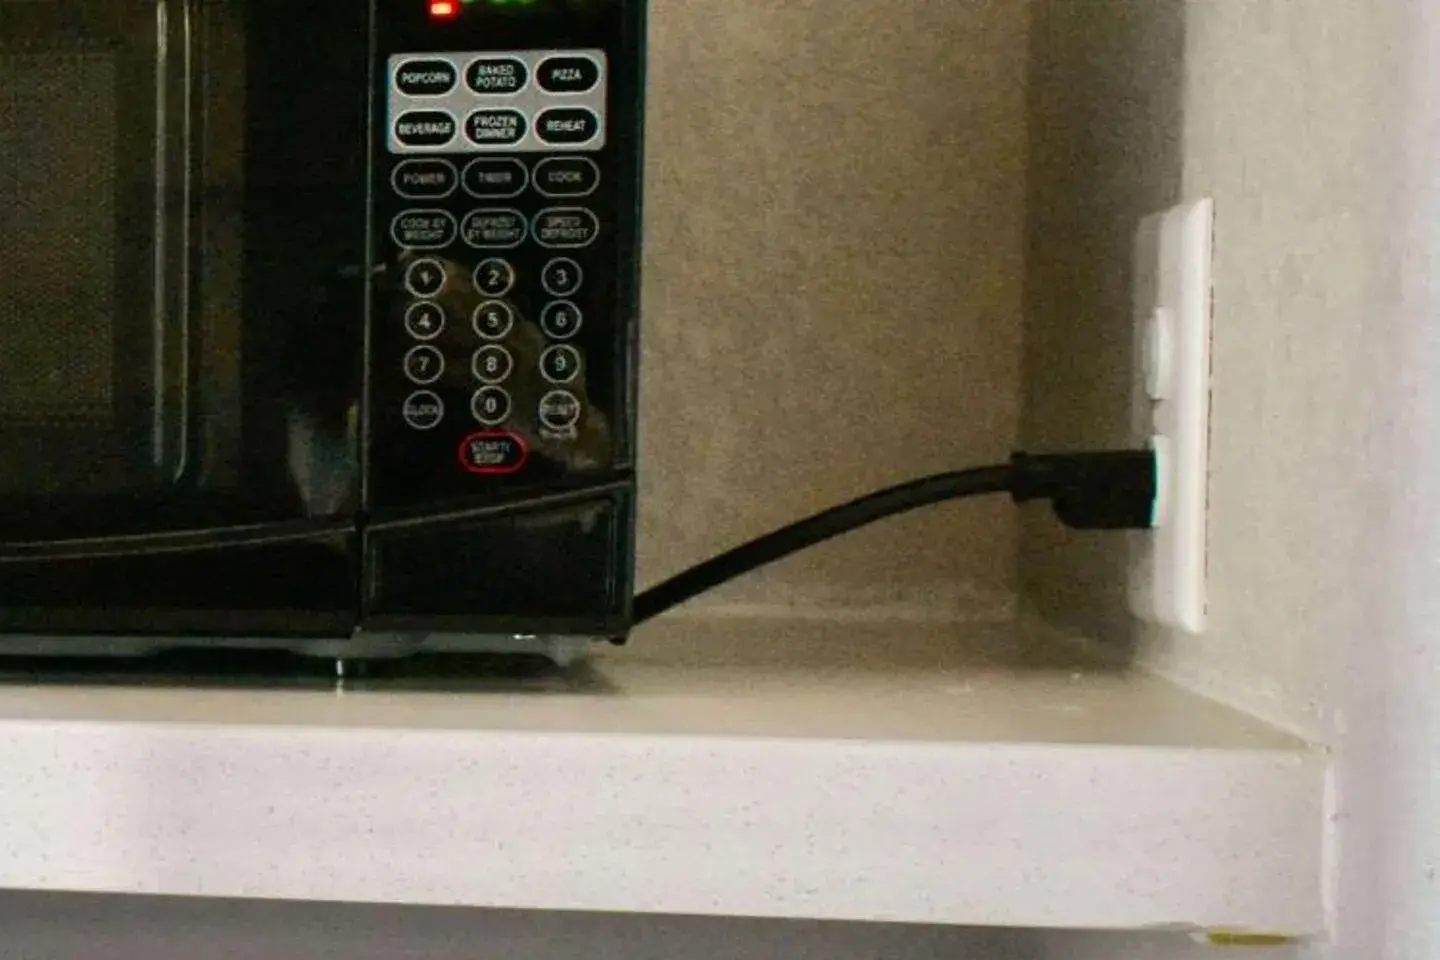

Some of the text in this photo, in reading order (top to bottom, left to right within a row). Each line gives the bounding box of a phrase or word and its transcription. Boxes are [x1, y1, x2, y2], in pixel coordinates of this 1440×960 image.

[401, 72, 450, 84] POPCORN
[478, 65, 513, 76] BAKED
[552, 69, 582, 80] PIZZA
[476, 77, 516, 88] POTATO
[398, 122, 451, 135] BEVERAGE
[474, 116, 516, 127] FROZEN
[547, 120, 585, 131] REHEAT
[476, 128, 516, 139] DINNER
[419, 271, 431, 286] 1
[488, 270, 499, 285] 2
[556, 269, 567, 285] 3
[417, 313, 430, 329] 4
[487, 312, 499, 328] 5
[555, 311, 567, 327] 6
[418, 356, 430, 371] 7
[486, 356, 498, 372] 8
[555, 355, 566, 371] 9
[486, 397, 497, 413] 0
